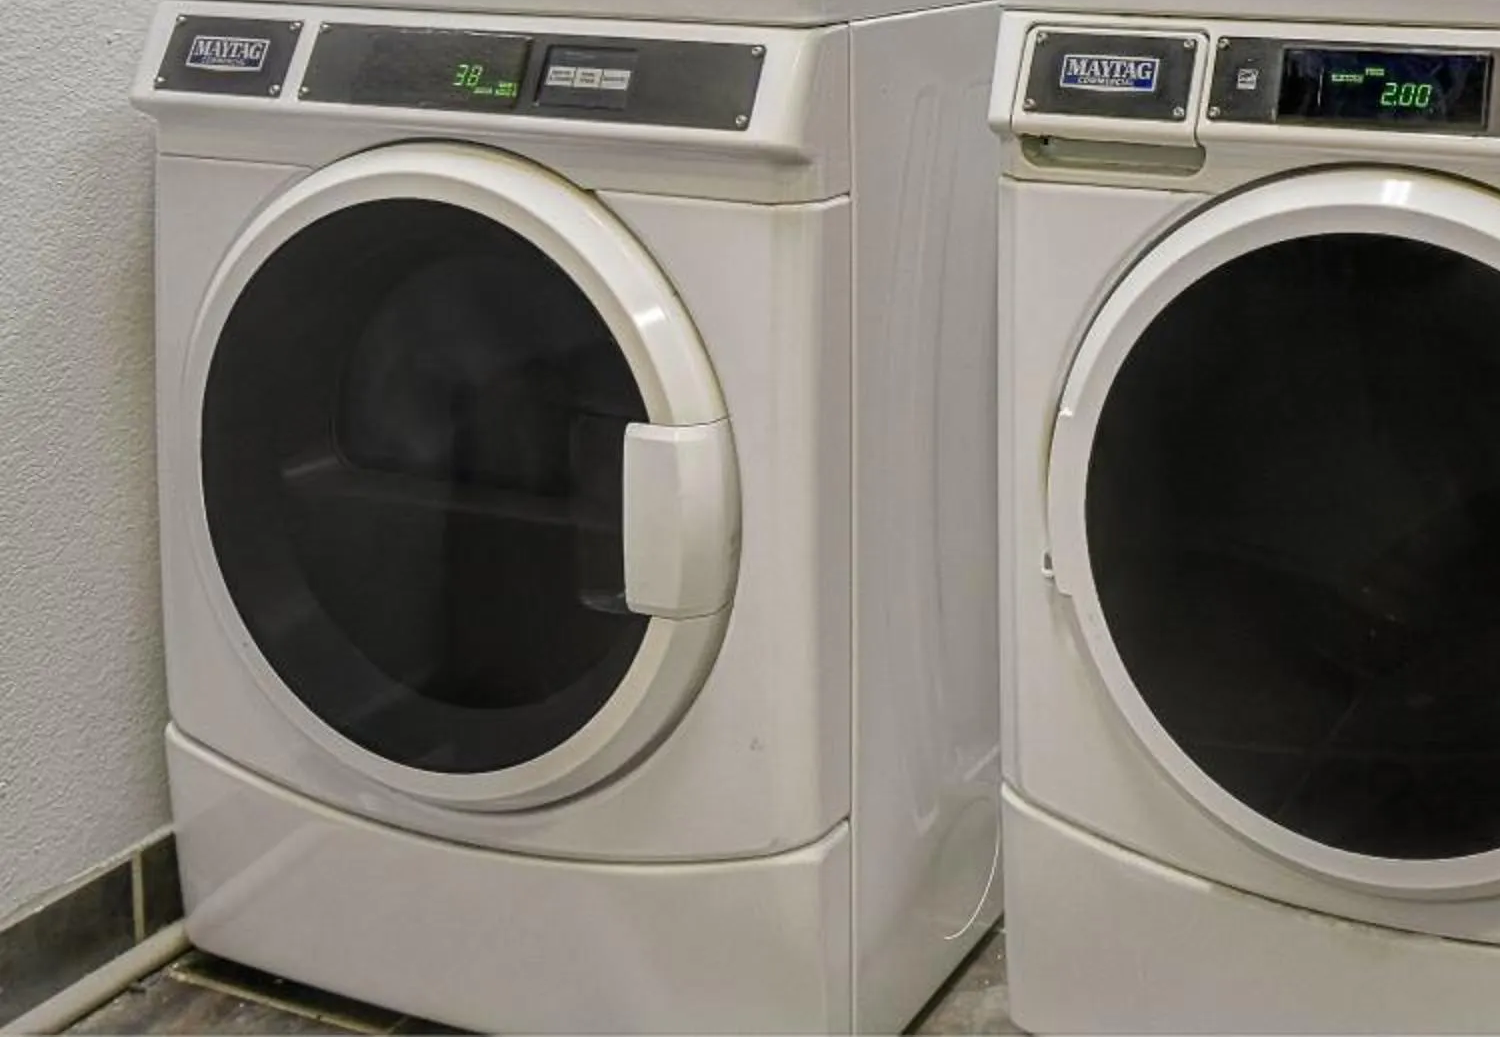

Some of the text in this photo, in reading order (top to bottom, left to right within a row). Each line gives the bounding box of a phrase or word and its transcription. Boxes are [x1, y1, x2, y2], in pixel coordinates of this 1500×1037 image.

[192, 40, 263, 60] MAYTAG
[453, 64, 483, 86] 38
[1066, 58, 1152, 80] MAYTAG
[1381, 82, 1432, 108] 2.00
